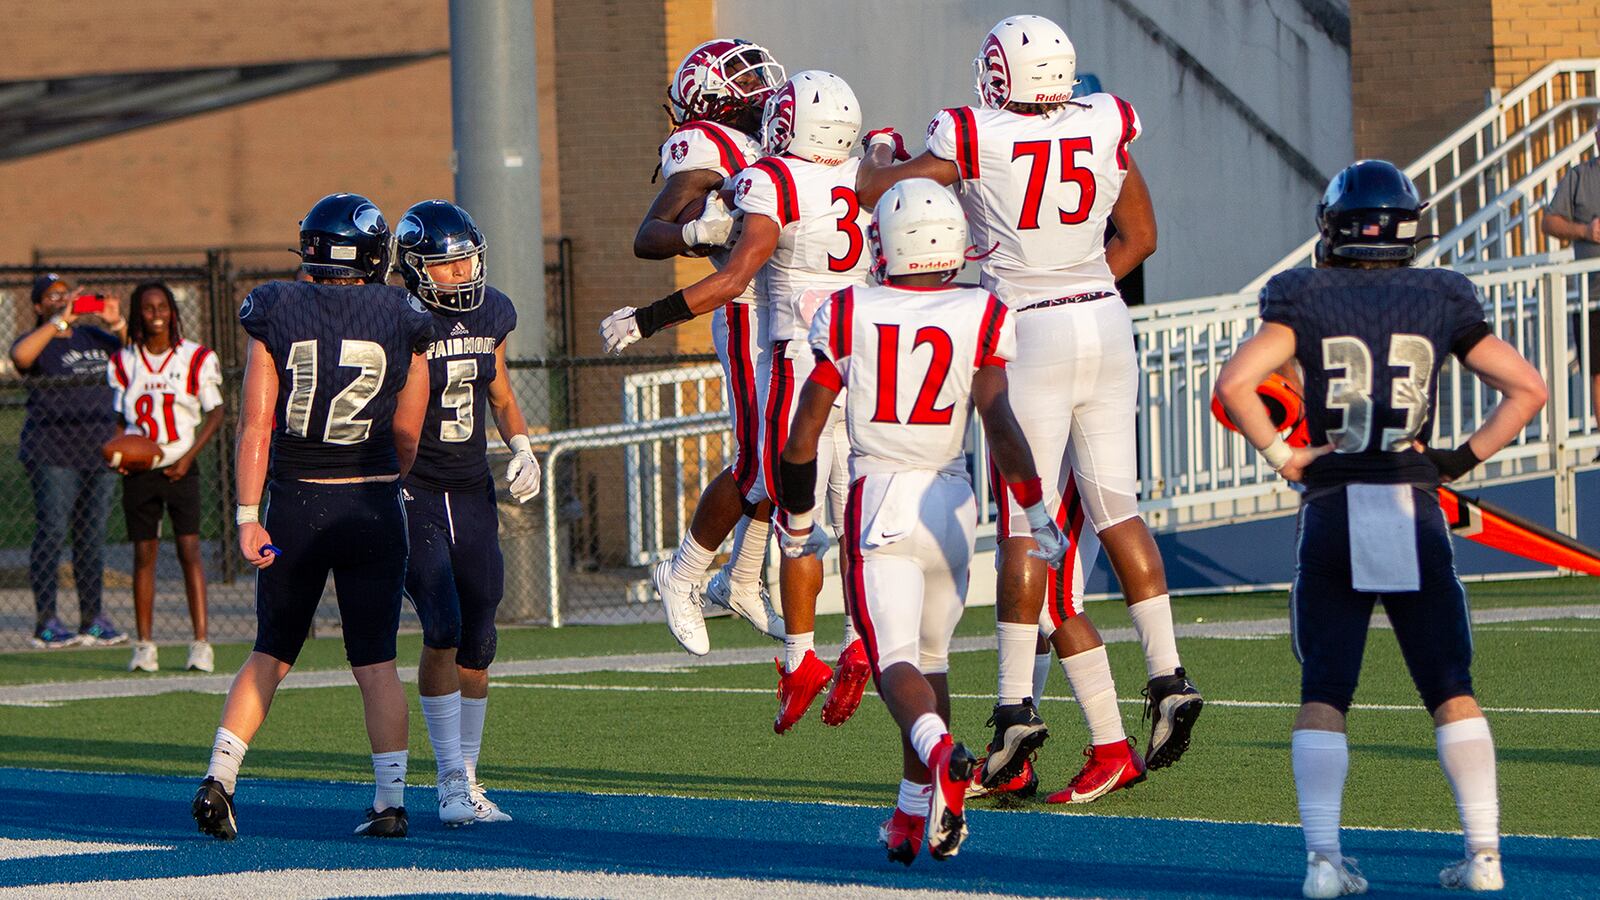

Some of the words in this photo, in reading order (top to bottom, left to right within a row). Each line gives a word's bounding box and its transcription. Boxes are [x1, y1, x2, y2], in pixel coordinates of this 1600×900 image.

[828, 186, 864, 273] 3
[1010, 136, 1097, 230] 75
[135, 392, 181, 444] 81
[286, 339, 387, 445] 12
[439, 358, 478, 443] 5
[870, 323, 955, 425] 12
[1321, 333, 1435, 454] 33
